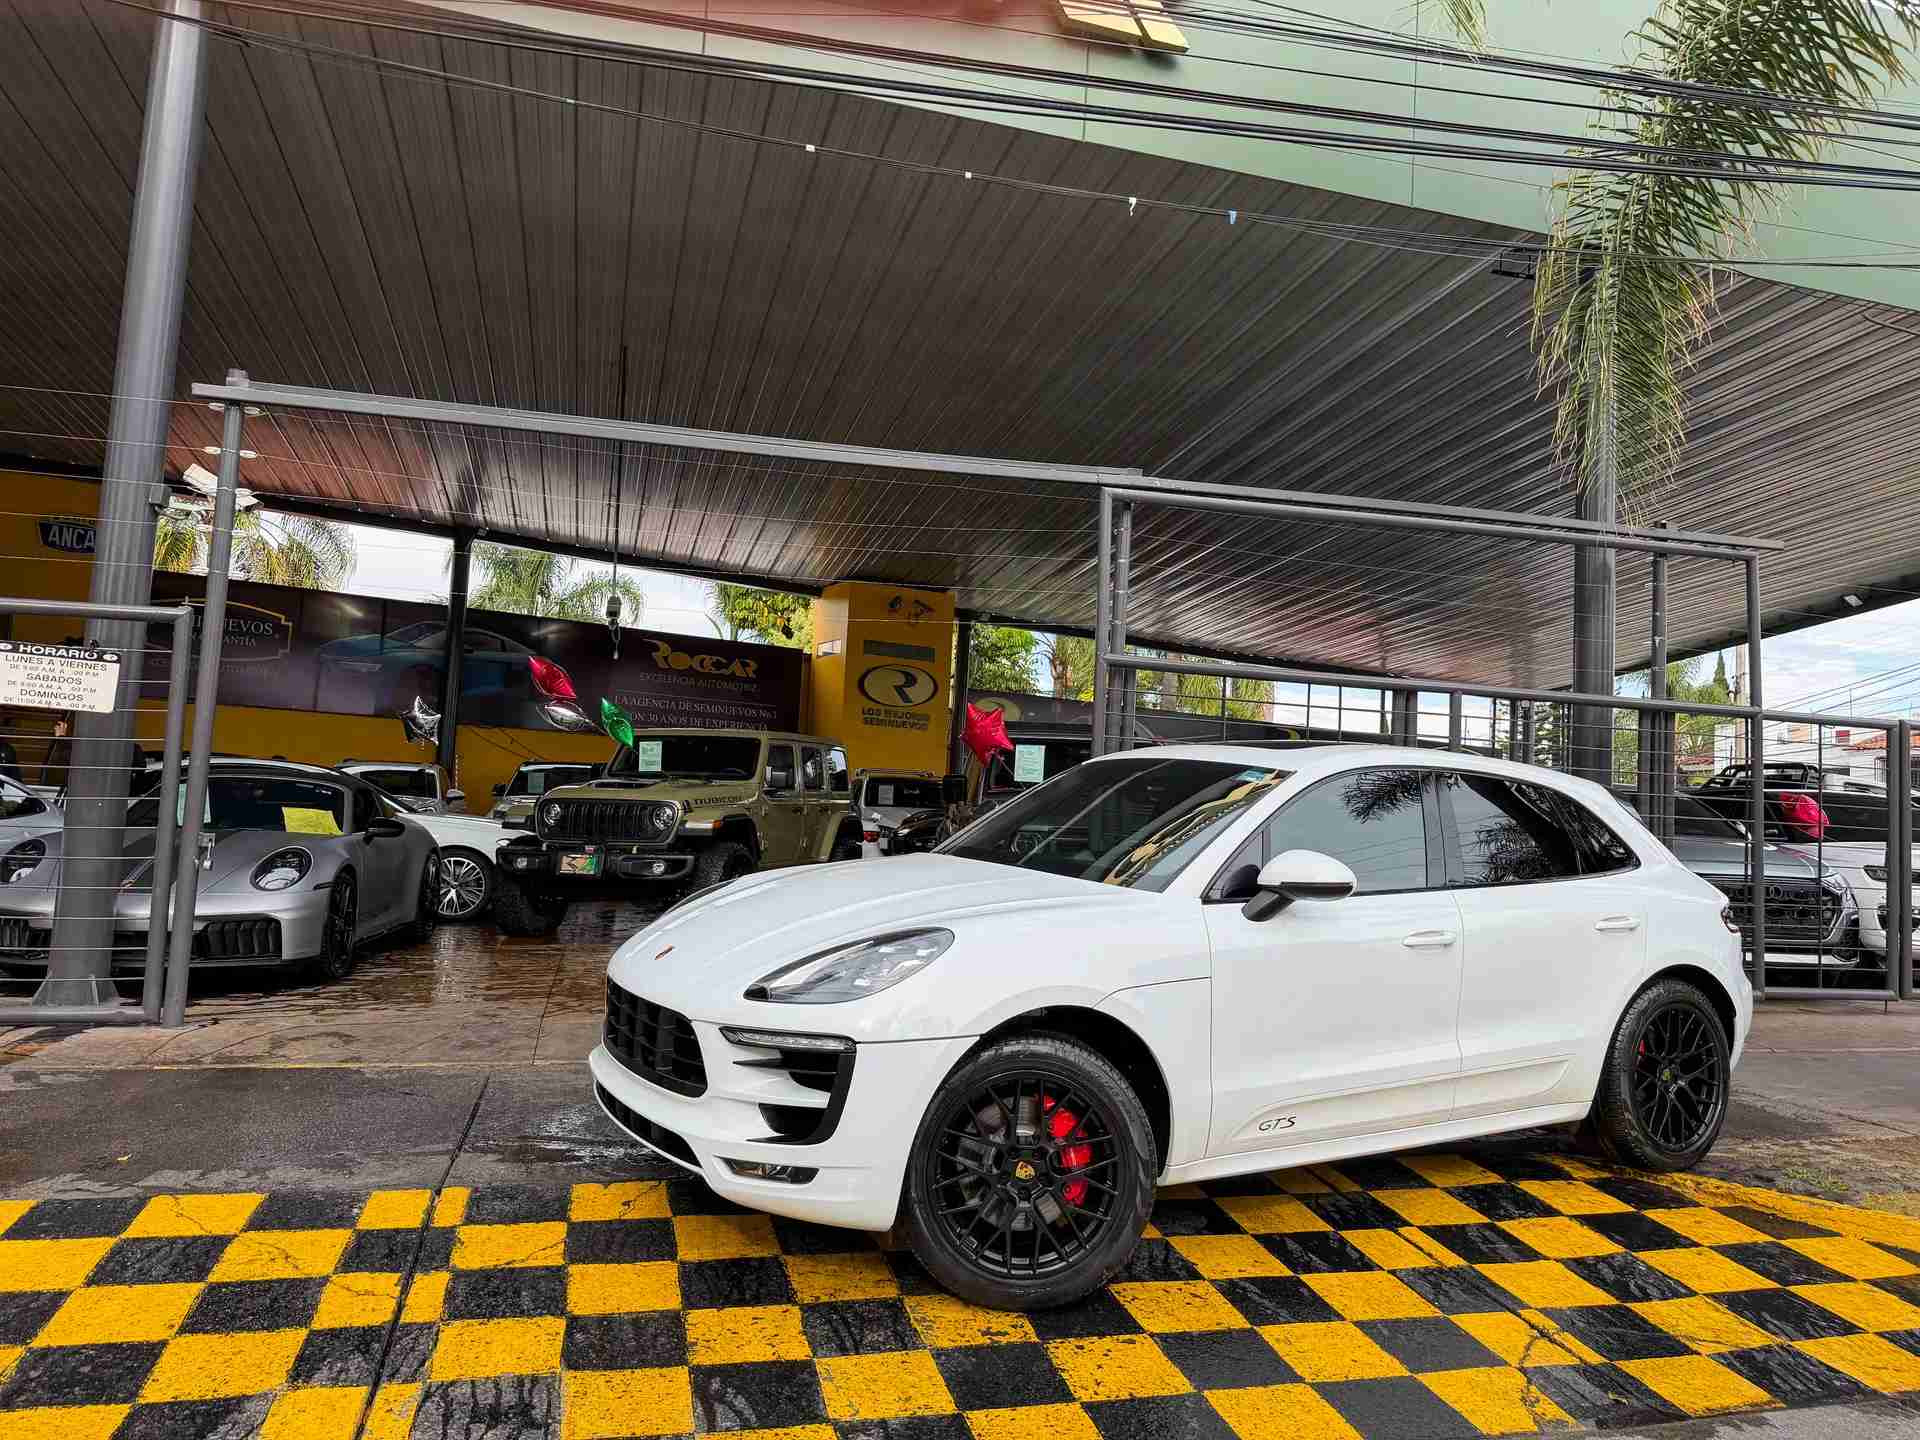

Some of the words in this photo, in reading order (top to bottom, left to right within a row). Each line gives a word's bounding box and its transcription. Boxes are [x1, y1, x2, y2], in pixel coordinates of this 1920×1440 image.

[19, 644, 98, 660] HORARIO
[641, 638, 759, 678] ROCCAR
[5, 654, 44, 666] LUNES
[60, 659, 108, 672] VIERNES
[20, 688, 84, 702] DOMINGOS
[679, 700, 691, 711] DE
[693, 703, 757, 719] SEMINUEVOS
[1258, 1116, 1297, 1131] GTS
